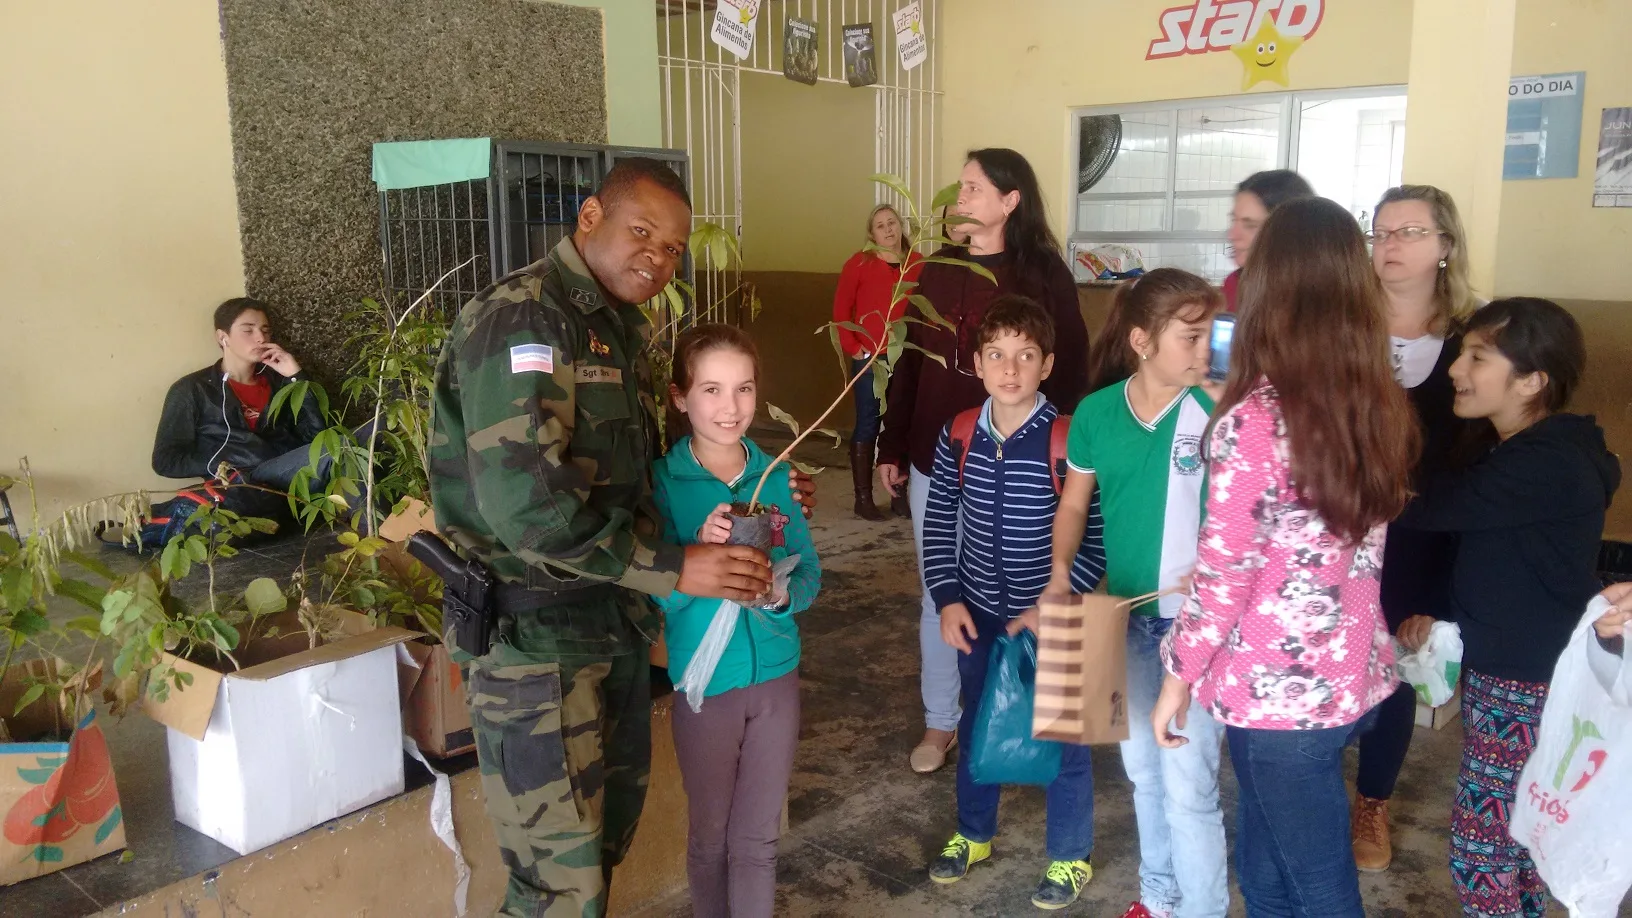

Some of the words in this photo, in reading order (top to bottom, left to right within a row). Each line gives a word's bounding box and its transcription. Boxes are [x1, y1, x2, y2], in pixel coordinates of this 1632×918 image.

[715, 23, 748, 50] Alimentos
[716, 11, 743, 35] Gincana
[743, 29, 752, 41] de
[1523, 82, 1544, 95] DO
[1549, 79, 1574, 92] DIA
[583, 369, 597, 379] Sgt
